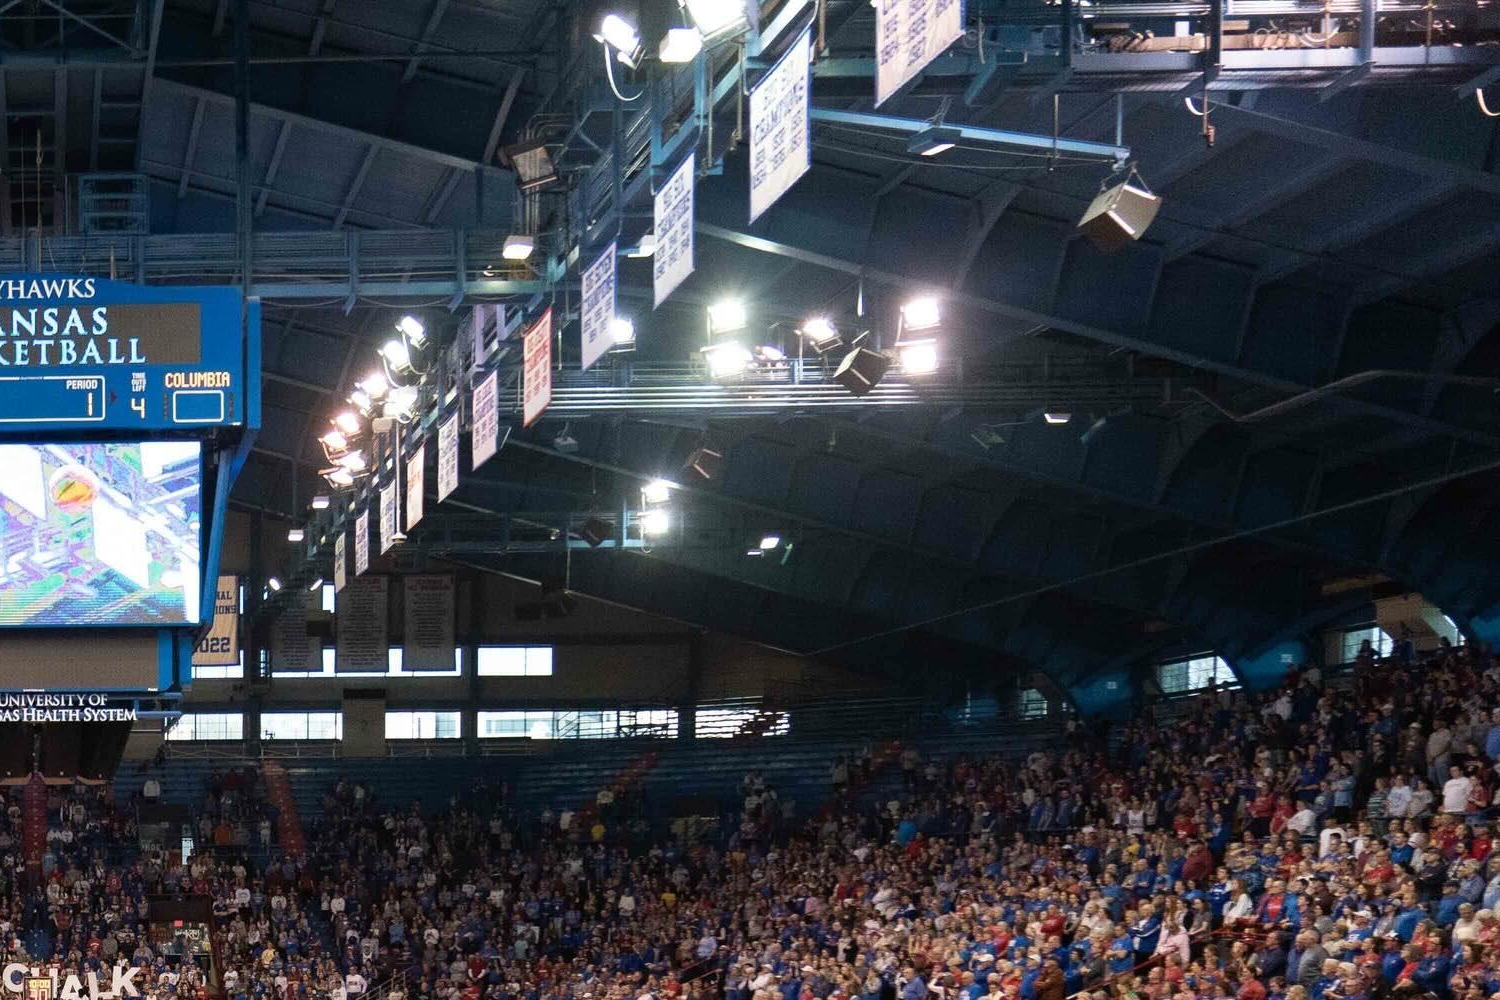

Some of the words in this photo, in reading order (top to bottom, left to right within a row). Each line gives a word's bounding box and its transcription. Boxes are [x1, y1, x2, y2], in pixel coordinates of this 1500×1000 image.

[131, 372, 146, 380] TIME
[165, 371, 230, 388] COLUMBIA
[66, 379, 98, 390] PERIOD
[87, 392, 93, 417] 1
[131, 398, 145, 419] 4
[197, 637, 230, 653] 022
[88, 694, 108, 706] OF
[22, 708, 80, 722] HEALTH
[83, 708, 138, 721] SYSTEM
